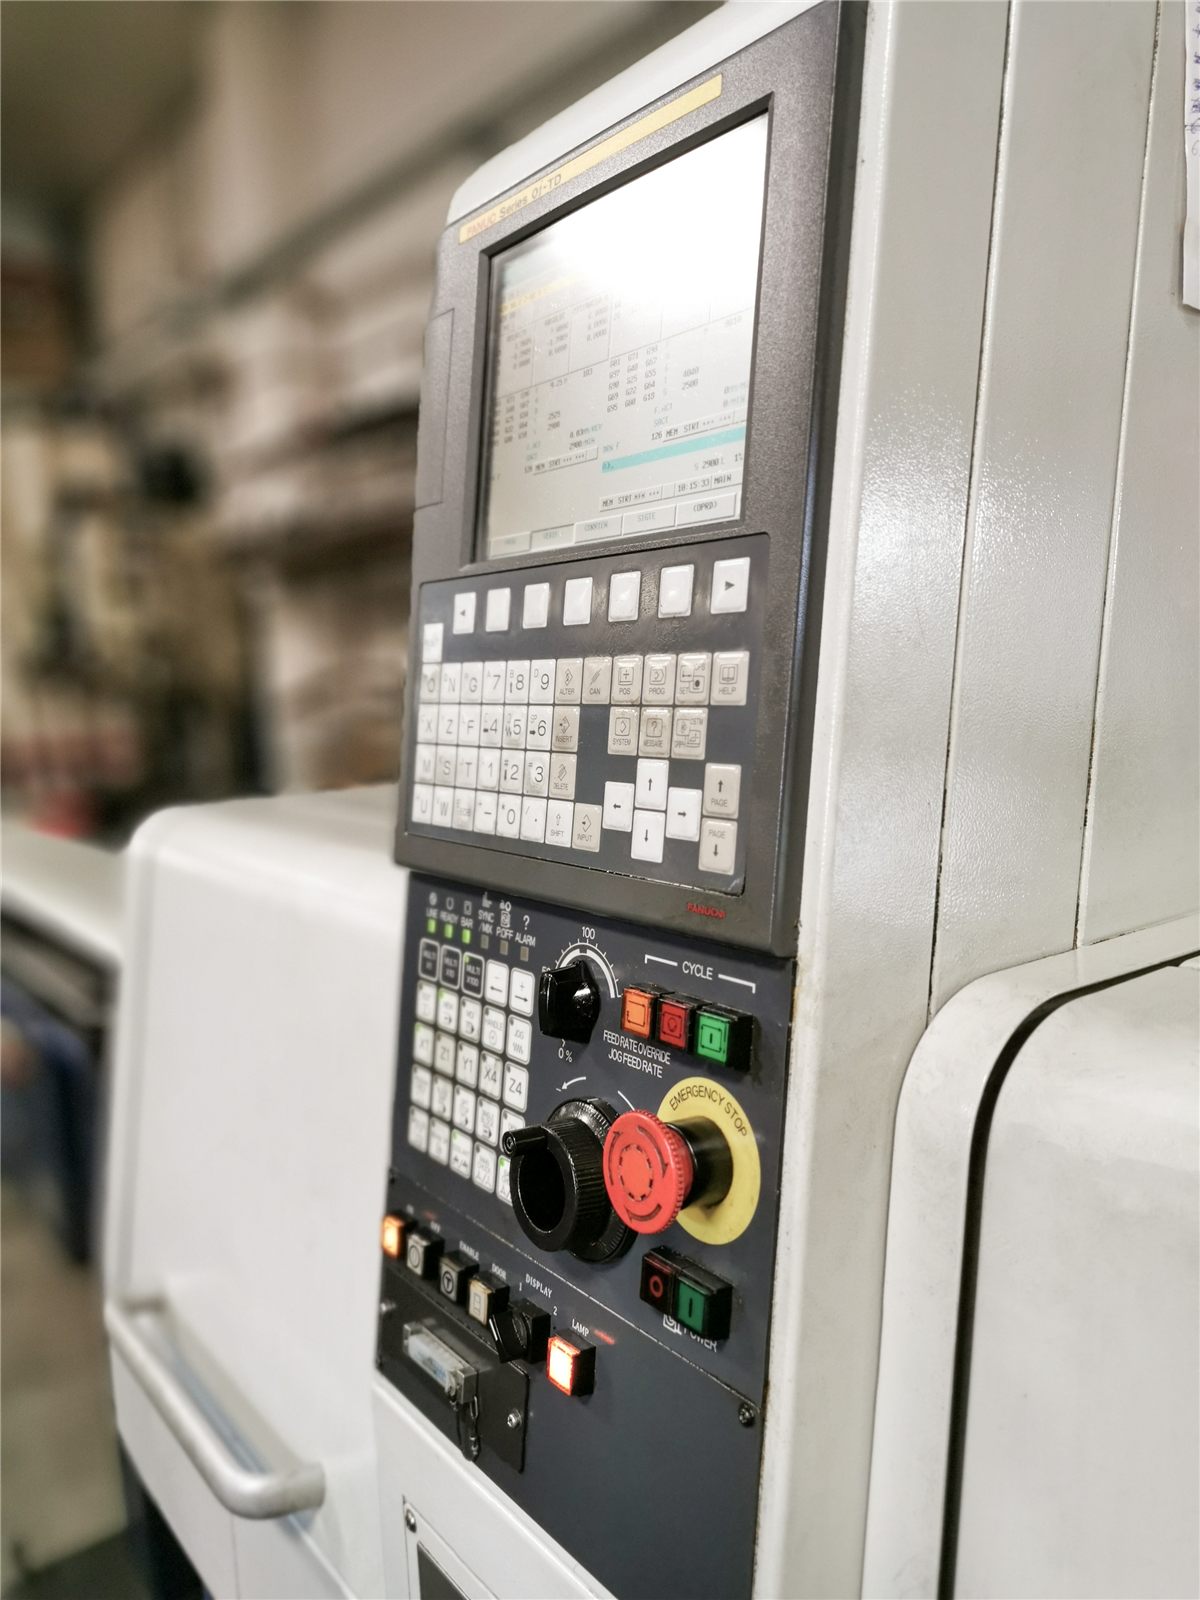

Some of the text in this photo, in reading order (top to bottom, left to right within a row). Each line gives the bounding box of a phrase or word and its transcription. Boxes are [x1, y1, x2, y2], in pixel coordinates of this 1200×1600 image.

[714, 474, 732, 485] MAIN
[492, 674, 501, 690] 7
[515, 673, 524, 691] 8
[540, 673, 550, 690] 9
[559, 687, 576, 695] ALTER
[618, 687, 631, 695] POS
[648, 687, 665, 695] PROG
[718, 687, 736, 695] HELP
[490, 718, 498, 734] 4
[513, 719, 522, 736] 5
[538, 720, 547, 736] 6
[612, 738, 631, 746] SYSTEM
[510, 764, 519, 780] 2
[534, 766, 544, 783] 3
[710, 798, 728, 807] PAGE
[577, 834, 592, 842] INPUT
[708, 828, 727, 839] PAGE
[460, 917, 474, 928] BAR
[478, 909, 495, 923] SYNC
[514, 932, 536, 947] ALARM
[582, 926, 595, 940] 100
[466, 964, 481, 975] MULTI
[682, 961, 714, 981] CYCLE
[466, 978, 480, 986] X100
[608, 1048, 623, 1064] JOG
[638, 1041, 671, 1064] OVERRIDE
[463, 1056, 473, 1072] Y1
[484, 1067, 497, 1083] X4
[510, 1077, 522, 1096] Z4
[669, 1085, 748, 1137] EMERGENCY STOP
[525, 1272, 553, 1299] DISPLAY
[551, 1305, 558, 1316] 2
[571, 1318, 591, 1337] LAMP
